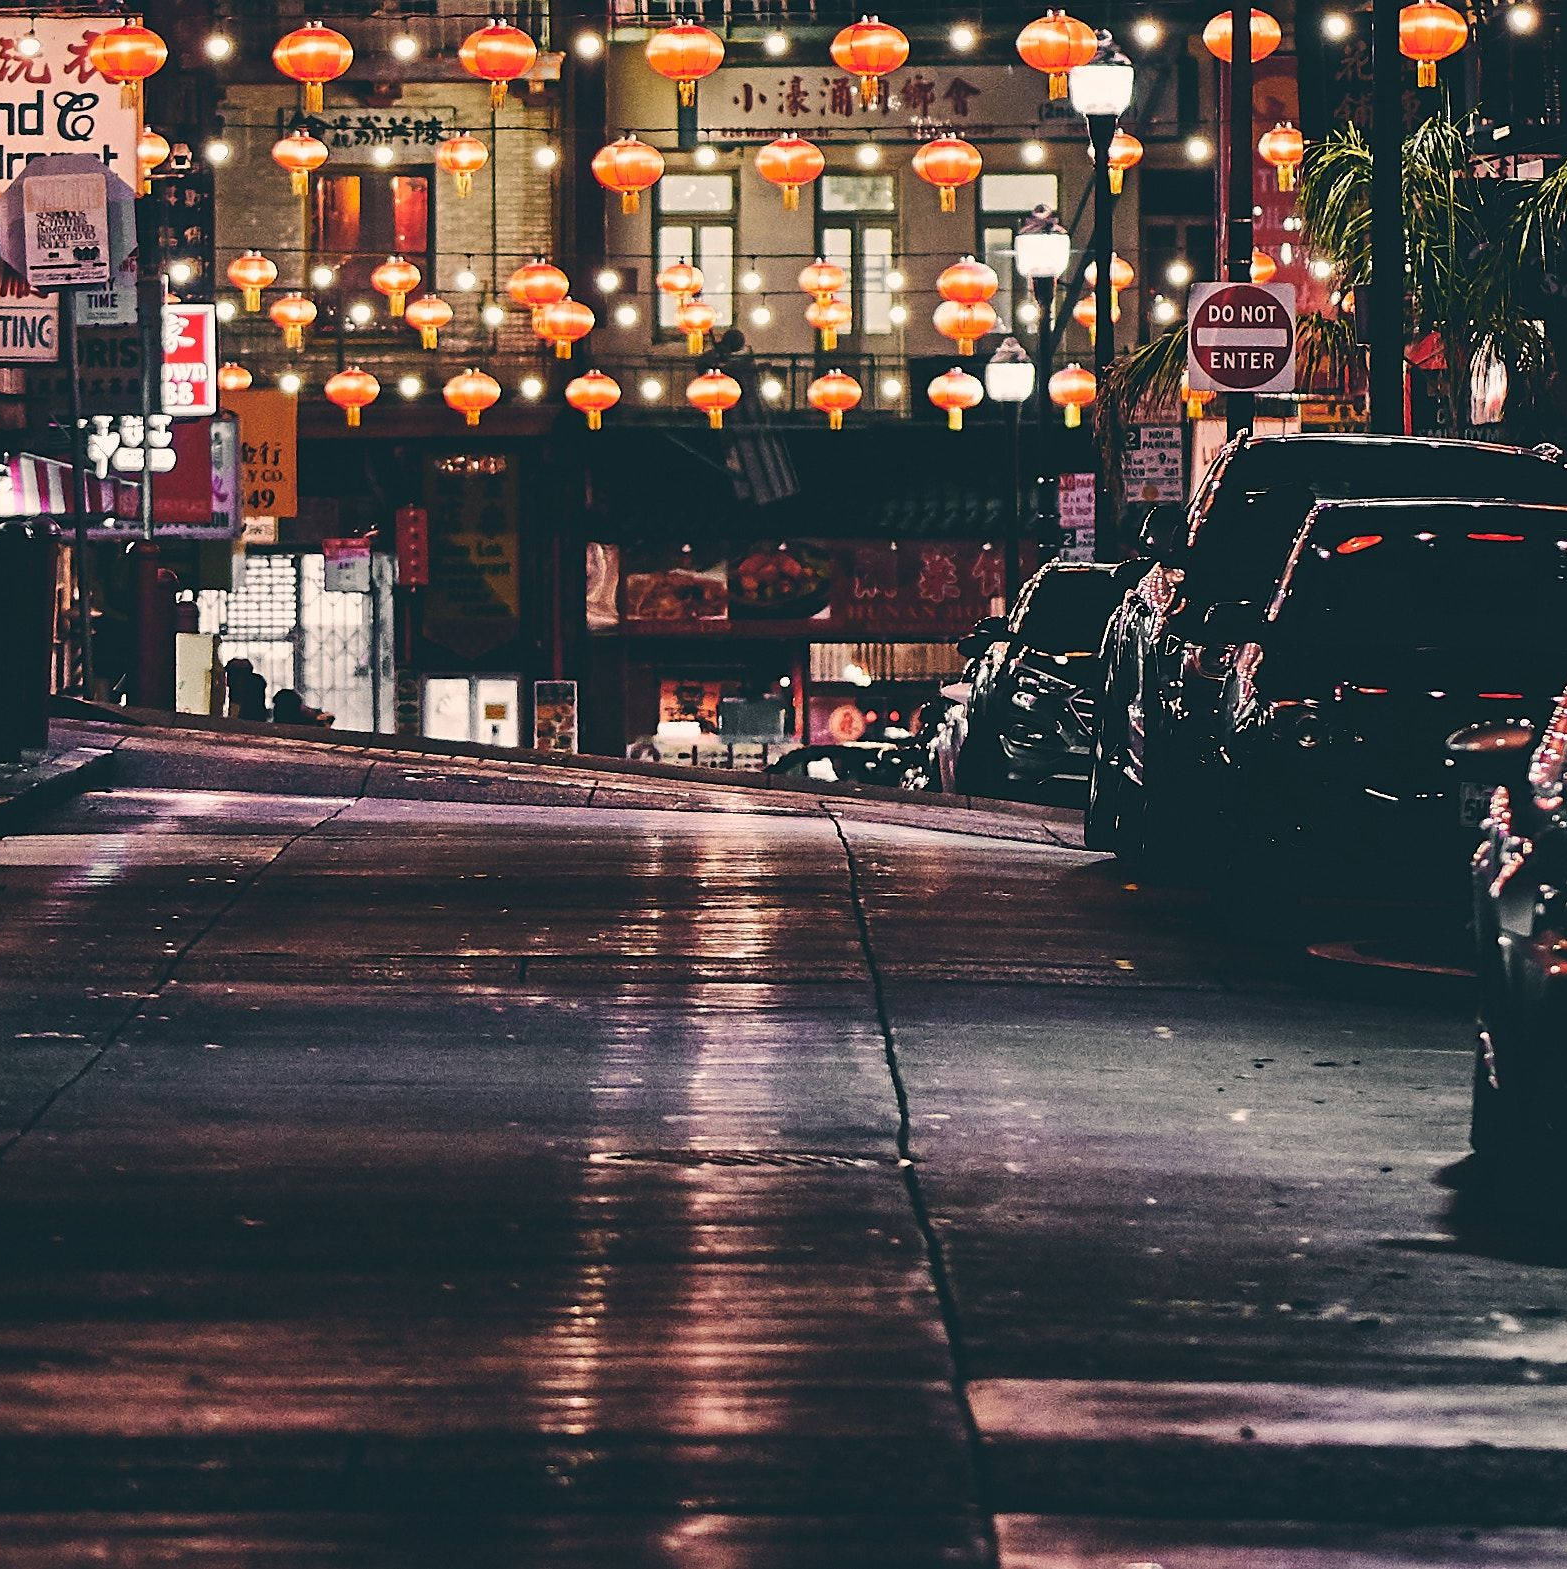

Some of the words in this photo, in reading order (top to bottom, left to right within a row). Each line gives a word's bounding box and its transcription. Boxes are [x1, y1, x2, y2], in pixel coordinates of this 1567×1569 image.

[87, 293, 118, 309] TIME
[1208, 304, 1234, 323] DO
[1240, 305, 1278, 323] NOT
[1210, 352, 1275, 370] ENTER
